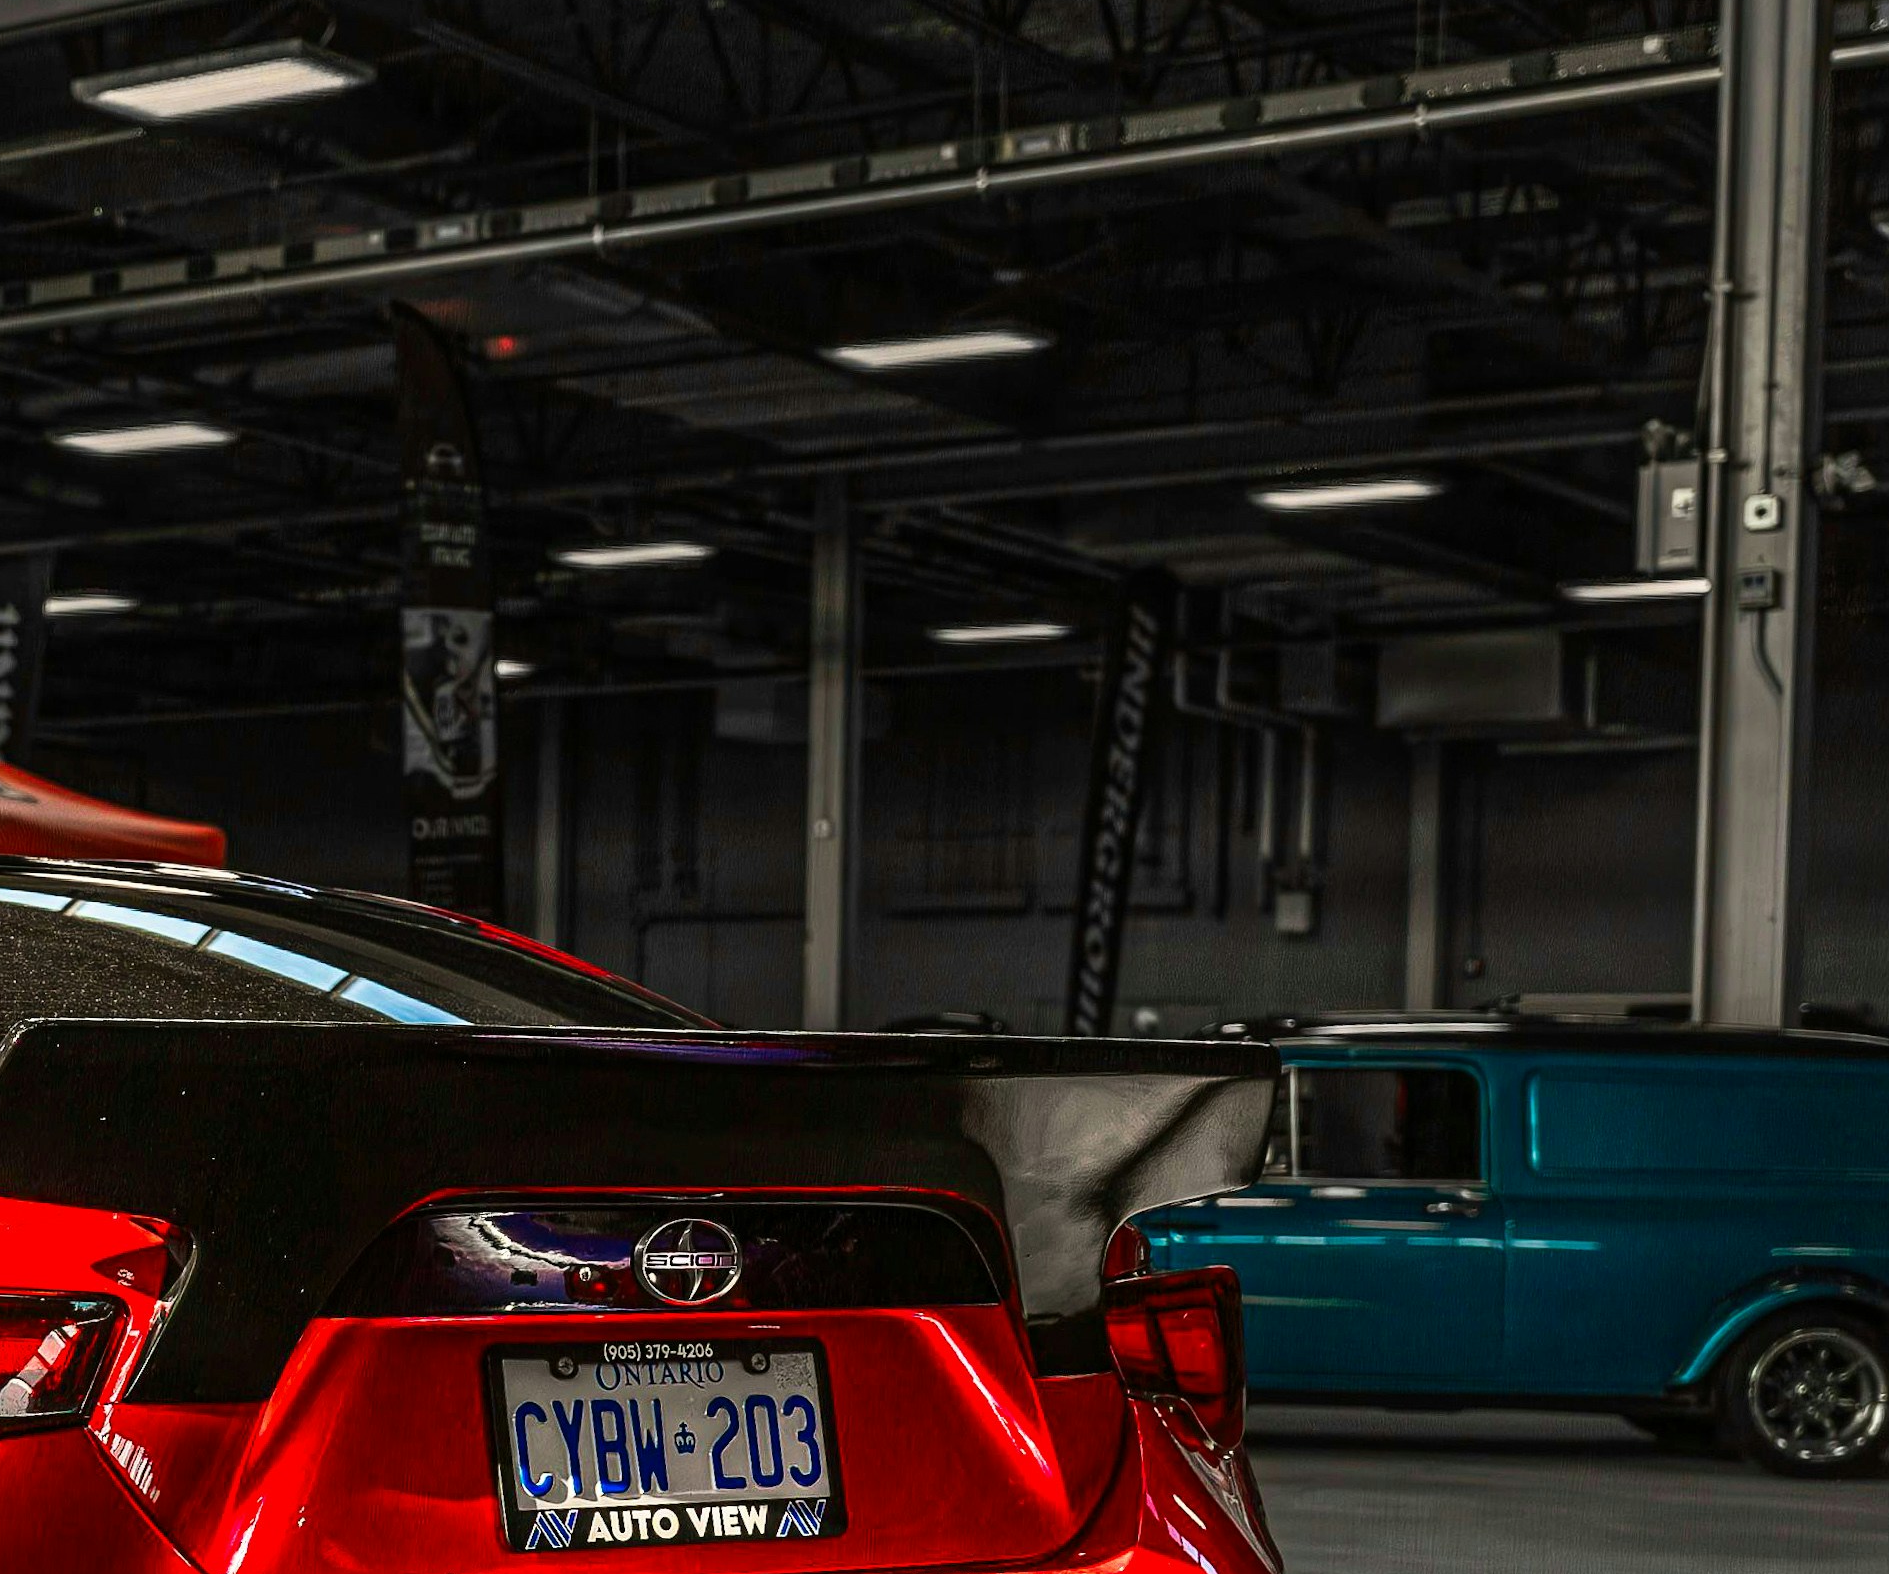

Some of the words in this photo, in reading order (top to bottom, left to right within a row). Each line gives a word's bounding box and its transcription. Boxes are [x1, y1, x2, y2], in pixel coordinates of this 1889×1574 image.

[646, 1254, 737, 1268] SCION
[603, 1343, 642, 1362] (905)
[645, 1343, 714, 1360] 379-4206
[595, 1360, 724, 1391] ONTARIO
[514, 1398, 669, 1498] CYBW
[705, 1394, 823, 1490] 203
[587, 1508, 682, 1544] AUTO
[685, 1504, 769, 1538] VIEW
